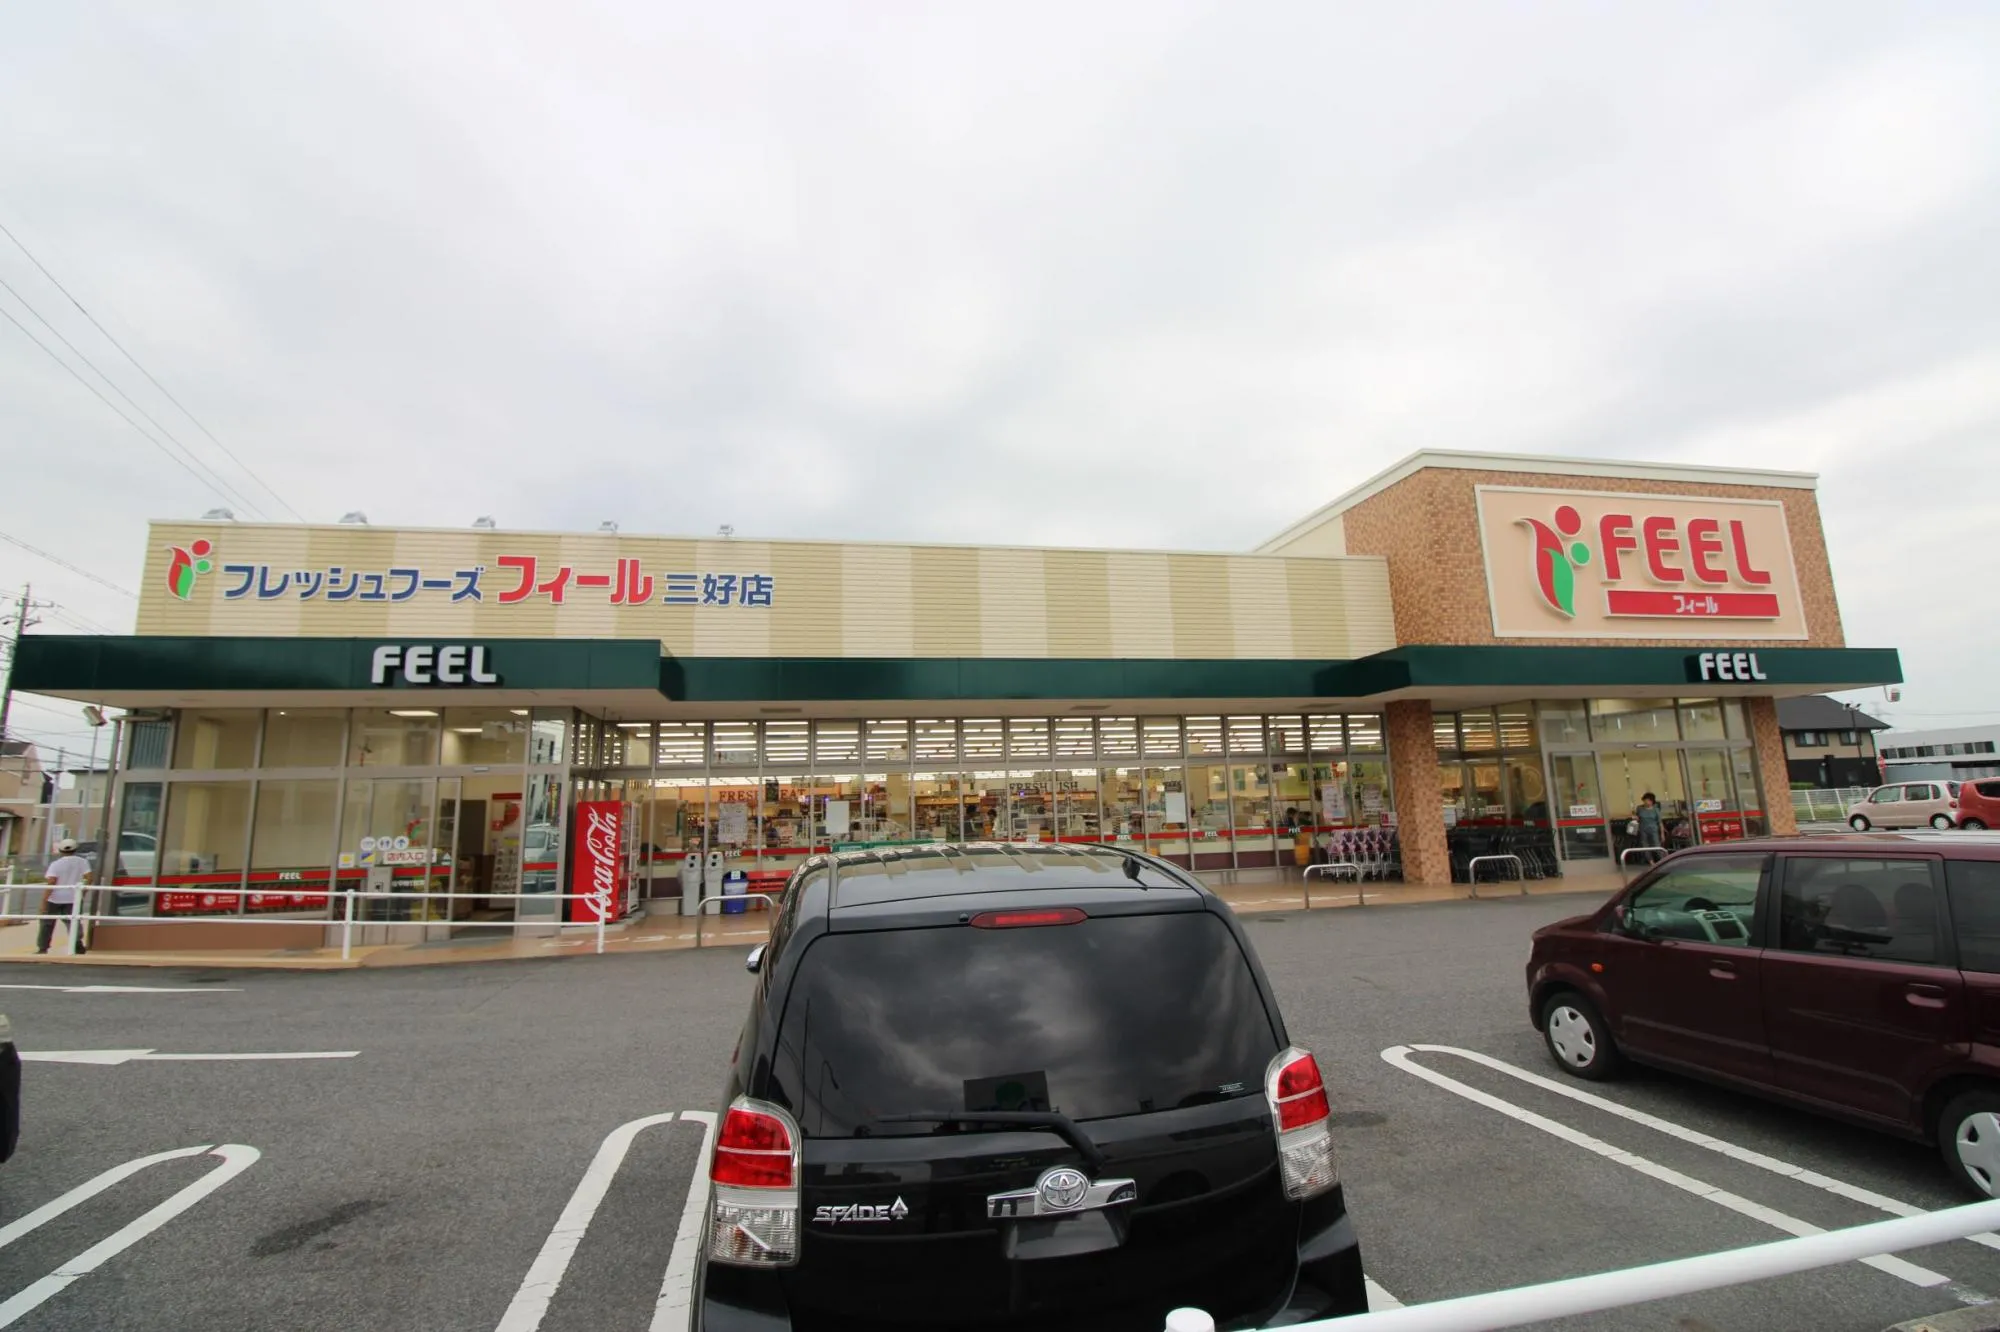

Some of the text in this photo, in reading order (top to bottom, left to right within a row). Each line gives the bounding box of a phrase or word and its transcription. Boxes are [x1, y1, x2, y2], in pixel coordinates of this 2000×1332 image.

[1599, 514, 1771, 584] FEEL
[223, 555, 773, 606] フレッシュフーズ フィール 三好店
[1673, 595, 1718, 614] フィール
[371, 646, 497, 683] FEEL
[1700, 653, 1767, 680] FEEL
[279, 872, 301, 880] FEEL
[584, 805, 618, 918] Coca-Cola
[812, 1203, 891, 1226] SPADE
